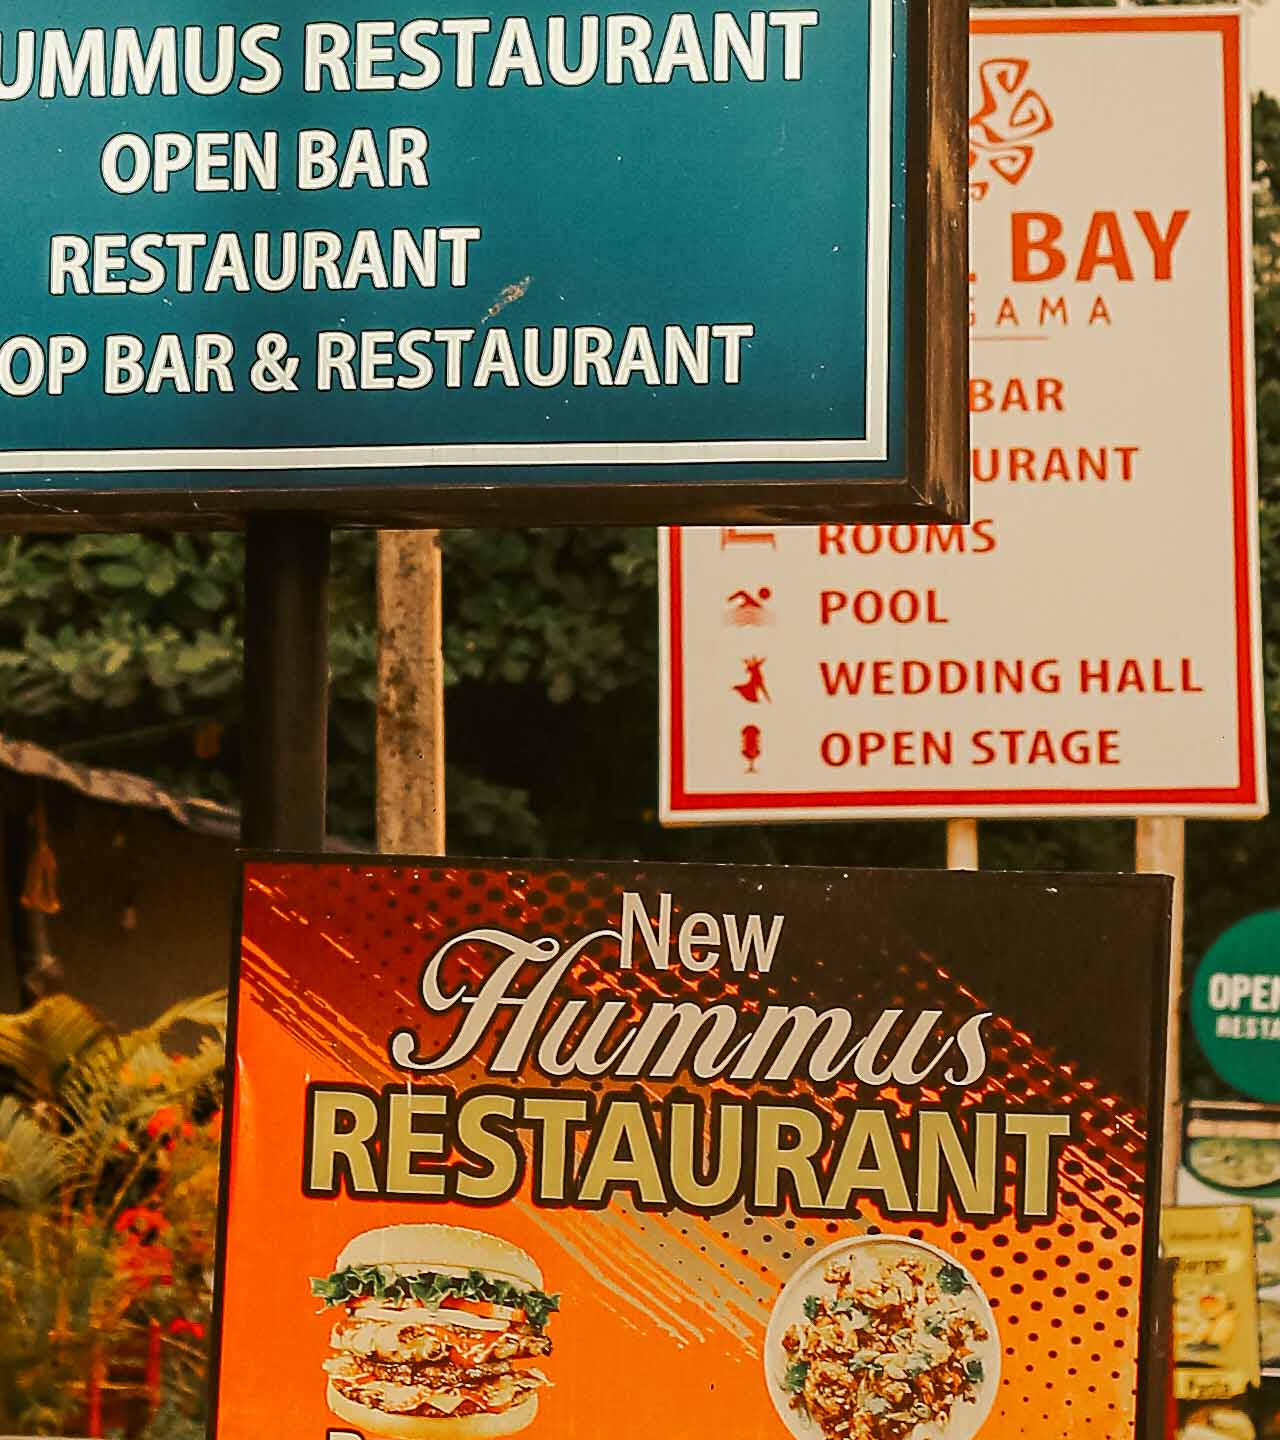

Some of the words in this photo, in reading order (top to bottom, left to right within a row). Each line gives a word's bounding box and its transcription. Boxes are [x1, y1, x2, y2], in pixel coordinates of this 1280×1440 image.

[305, 12, 817, 91] RESTAURANT
[102, 132, 276, 193] OPEN
[299, 128, 428, 189] BAR
[51, 228, 480, 294] RESTAURANT
[1011, 210, 1190, 282] BAY
[106, 334, 233, 393] BAR
[251, 333, 299, 391] &
[318, 325, 753, 389] RESTAURANT
[969, 376, 1063, 413] BAR
[973, 447, 1139, 482] URANT
[819, 519, 996, 555] ROOMS
[820, 590, 948, 625] POOL
[819, 659, 1060, 696] WEDDING
[1080, 658, 1203, 694] HALL
[821, 731, 952, 767] OPEN
[972, 730, 1120, 765] STAGE
[620, 892, 784, 974] New
[391, 928, 994, 1087] Hummus
[309, 1088, 1071, 1217] RESTAURANT
